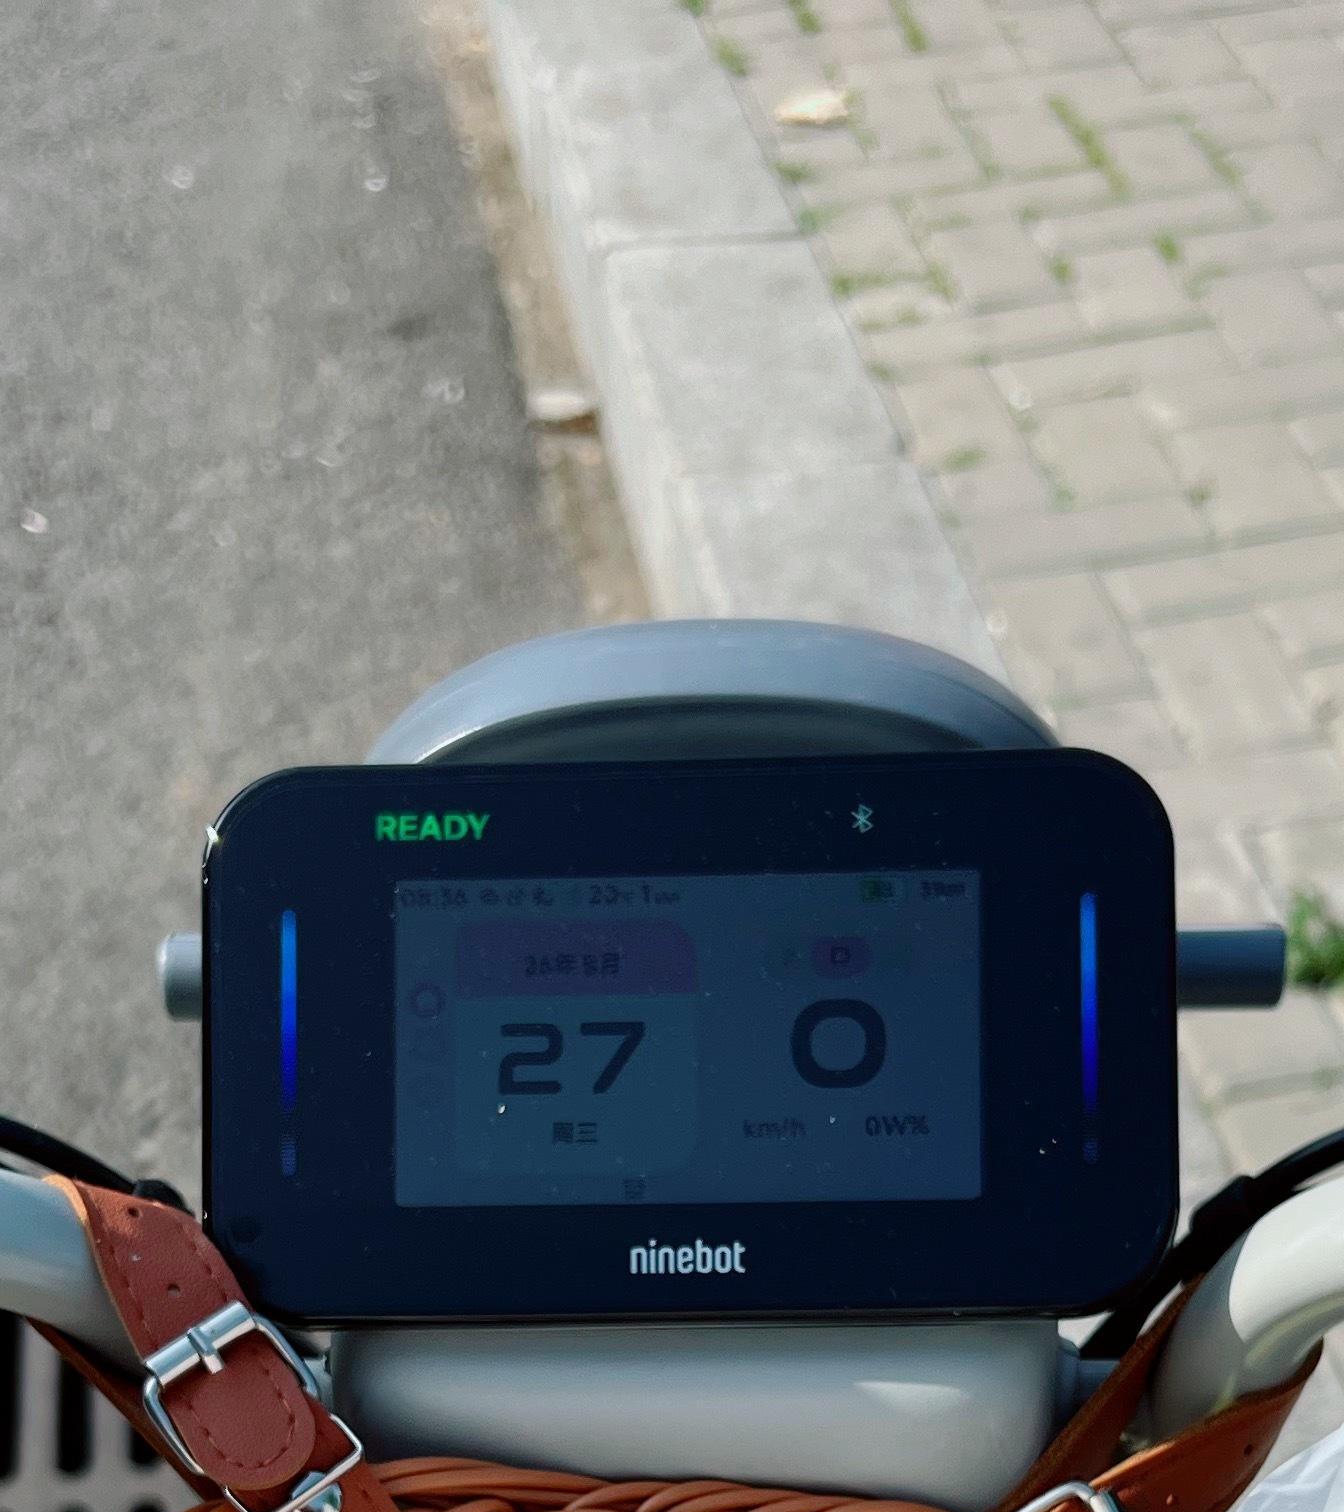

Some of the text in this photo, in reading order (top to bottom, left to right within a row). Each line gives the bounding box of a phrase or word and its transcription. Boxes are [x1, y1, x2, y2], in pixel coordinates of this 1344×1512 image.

[375, 813, 491, 842] READY
[498, 1020, 646, 1096] 27
[790, 997, 888, 1089] 0
[552, 1121, 599, 1145] 周三
[629, 1238, 746, 1274] ninebot
